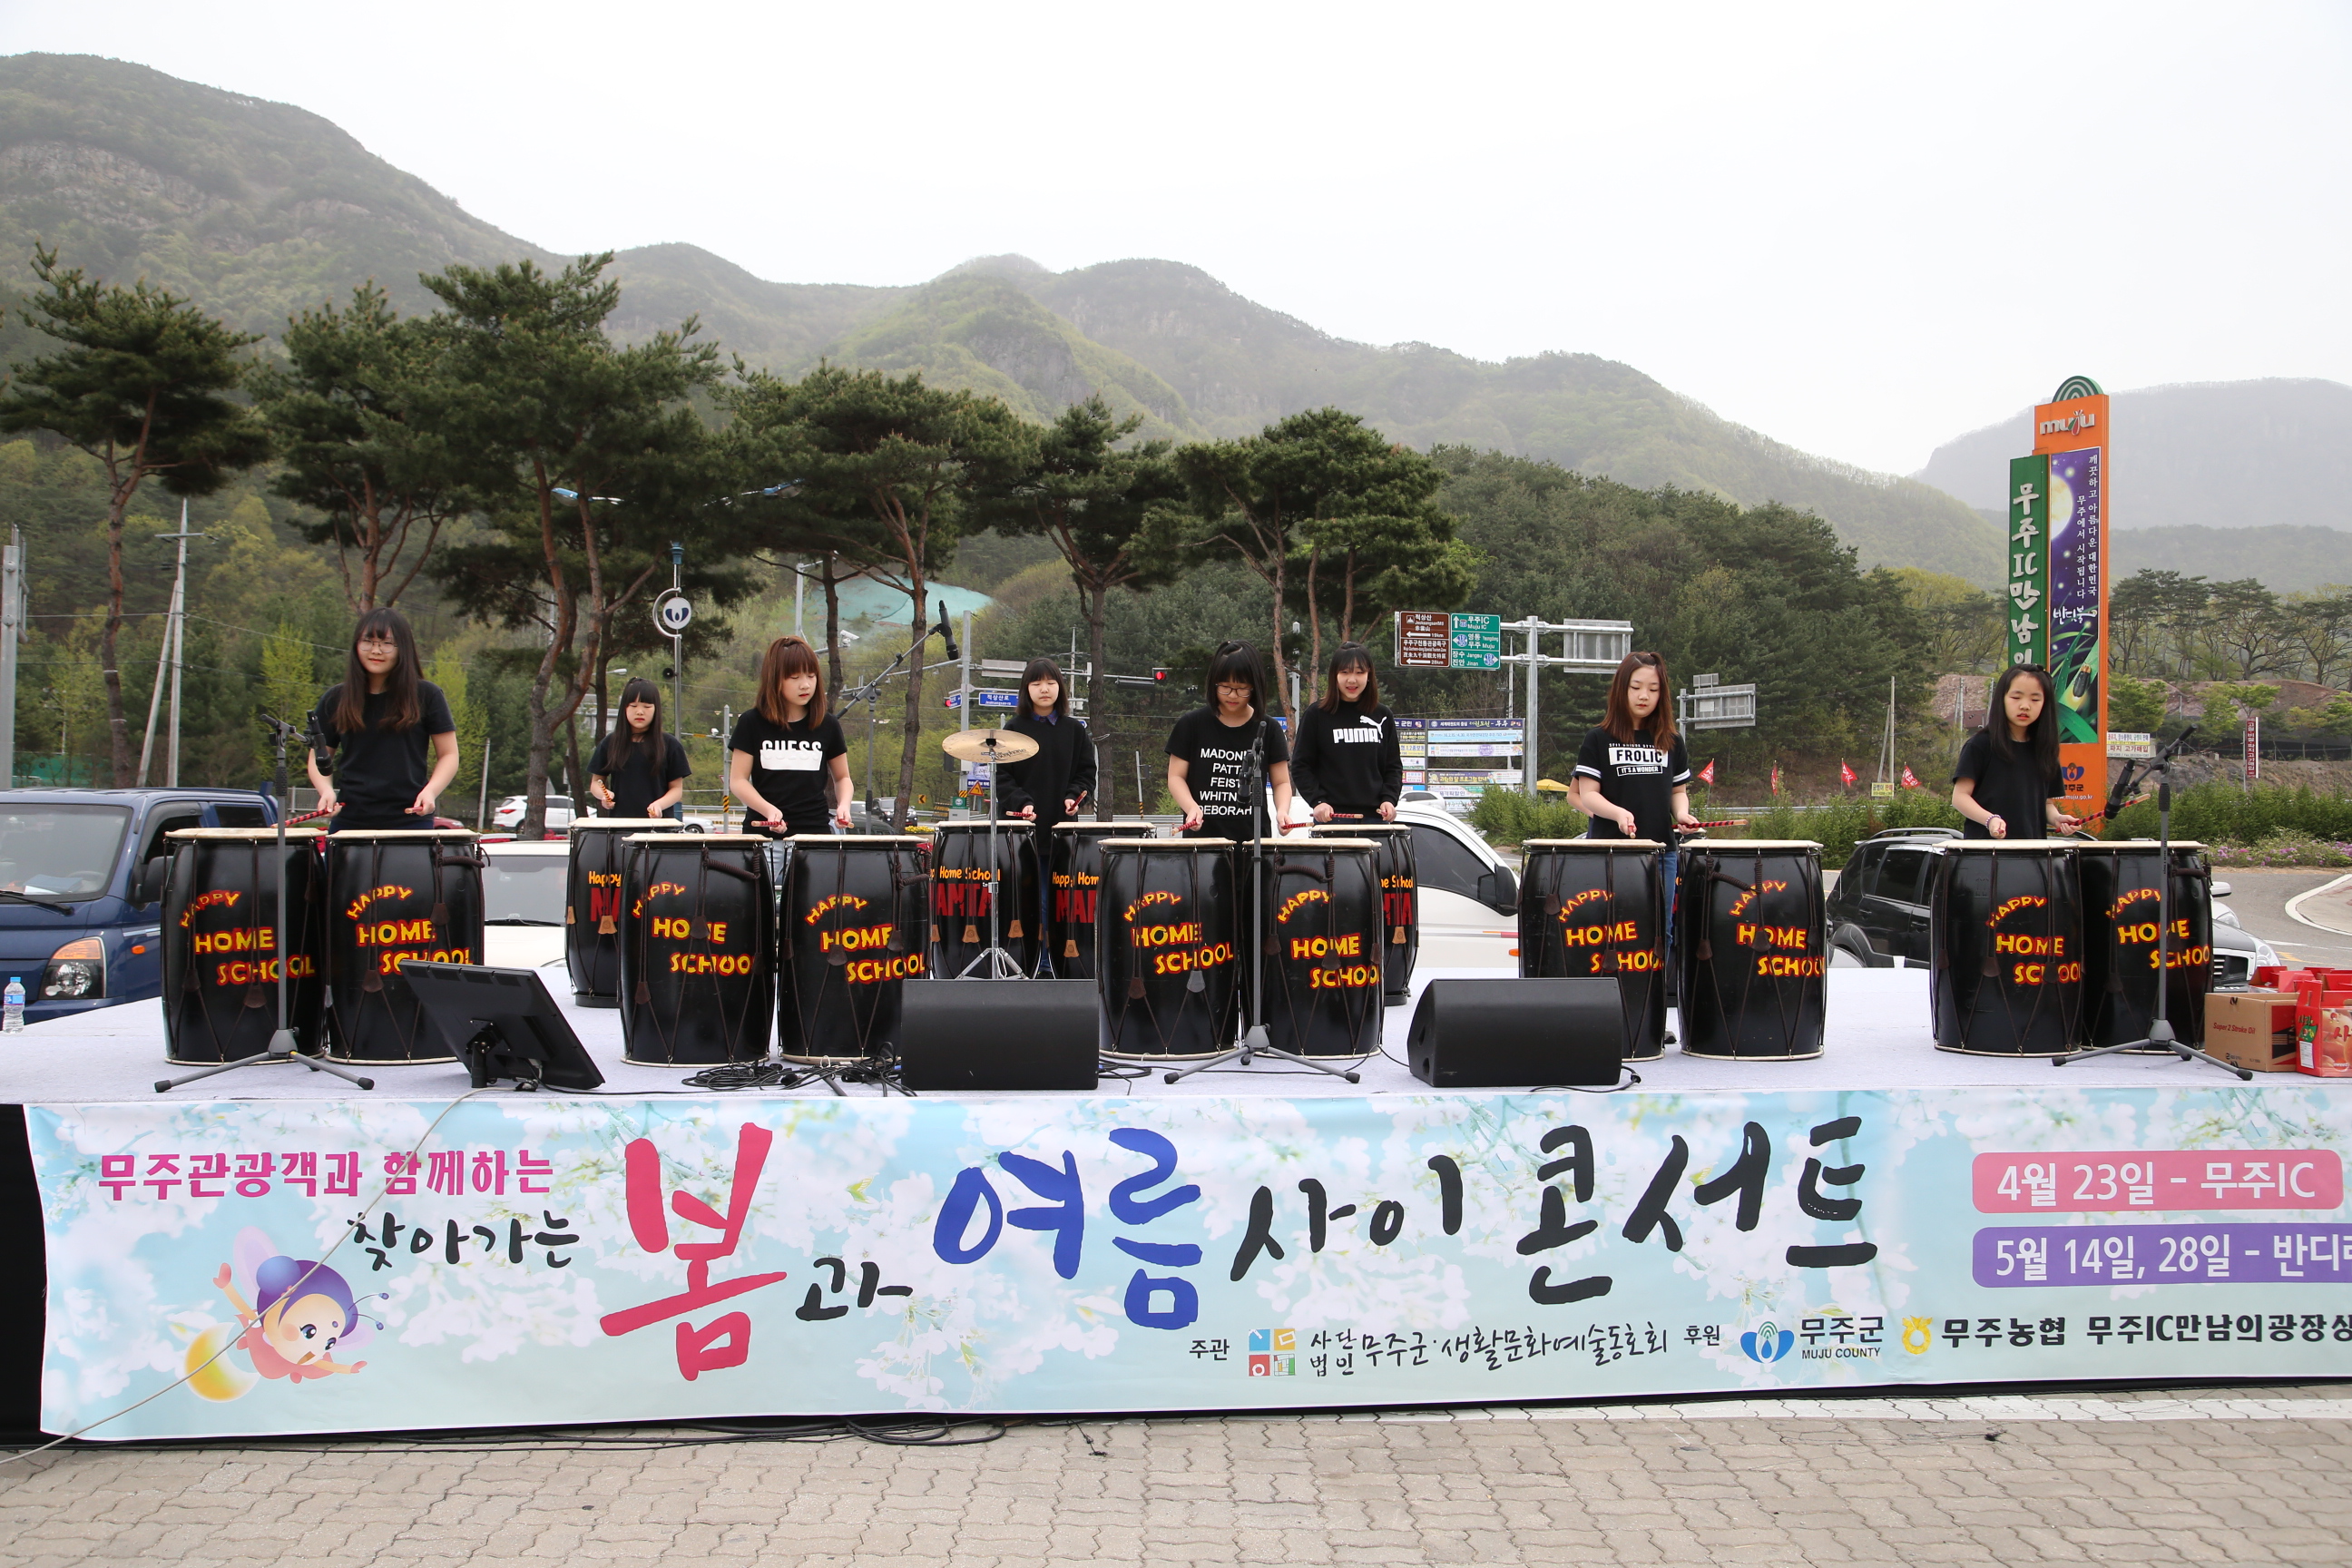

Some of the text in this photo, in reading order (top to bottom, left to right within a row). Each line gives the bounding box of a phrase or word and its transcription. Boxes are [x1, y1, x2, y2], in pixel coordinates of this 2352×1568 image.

[2039, 409, 2095, 436] muju
[2088, 455, 2098, 597] 깨끗하고 아름다운 대한민국
[2076, 495, 2086, 599] 무주에서 시작됩니다
[2009, 483, 2040, 664] 무주IC만남의
[1468, 616, 1490, 624] 무주IC
[1453, 659, 1465, 667] 진안
[1332, 728, 1378, 743] PUMA
[762, 740, 822, 760] GUESS
[1200, 748, 1247, 761] MADON
[1616, 750, 1662, 763] FROLIC
[1212, 762, 1242, 775] PATT
[1200, 790, 1238, 802] WHITN
[1210, 777, 1240, 789] FEIST
[588, 871, 622, 887] Happy
[939, 866, 963, 880] Home
[965, 867, 1001, 882] Schol
[1077, 872, 1099, 886] Hom
[346, 884, 413, 920] HAPPY
[805, 894, 868, 926] HAPPY
[1278, 889, 1335, 924] HAPPY
[1557, 888, 1614, 923] HAPPY
[195, 926, 275, 955] HOME
[356, 919, 436, 947] HOME
[652, 916, 728, 944] HOE
[820, 924, 893, 952] HOME
[1132, 922, 1203, 948] HOME
[1565, 920, 1638, 948] HOME
[1290, 933, 1361, 960] HOME
[1995, 933, 2064, 956] HOME
[2149, 944, 2210, 970] SCHOO
[216, 955, 316, 986] SCHOOL
[669, 951, 753, 975] SCHOO
[845, 952, 926, 985] SCHOOL
[1153, 942, 1234, 975] SCHOOL
[1590, 948, 1664, 974] SHOO
[2013, 962, 2081, 986] SCOOL
[2213, 1022, 2227, 1032] Super
[2232, 1024, 2248, 1034] Stroke
[2248, 1026, 2256, 1034] Oil
[98, 1148, 554, 1201] 무주관광객과 함께하는
[1996, 1162, 2057, 1207] 4월
[2073, 1161, 2154, 1205] 23일
[2200, 1161, 2316, 1200] 무주IC
[933, 1127, 1203, 1330] 여름
[1515, 1115, 1878, 1306] 콘서트
[347, 1210, 580, 1272] 찾아가는
[1996, 1237, 2047, 1281] 5월
[2063, 1235, 2146, 1279] 14일,
[2159, 1234, 2230, 1278] 28일
[1683, 1325, 1720, 1347] 후원
[1798, 1316, 1885, 1347] 무주군
[1941, 1317, 2067, 1350] 무주농협
[1189, 1338, 1230, 1362] 주관
[1310, 1330, 1357, 1351] 사단
[1801, 1347, 1883, 1360] MUJU COUNTY
[1310, 1351, 1356, 1377] 법인
